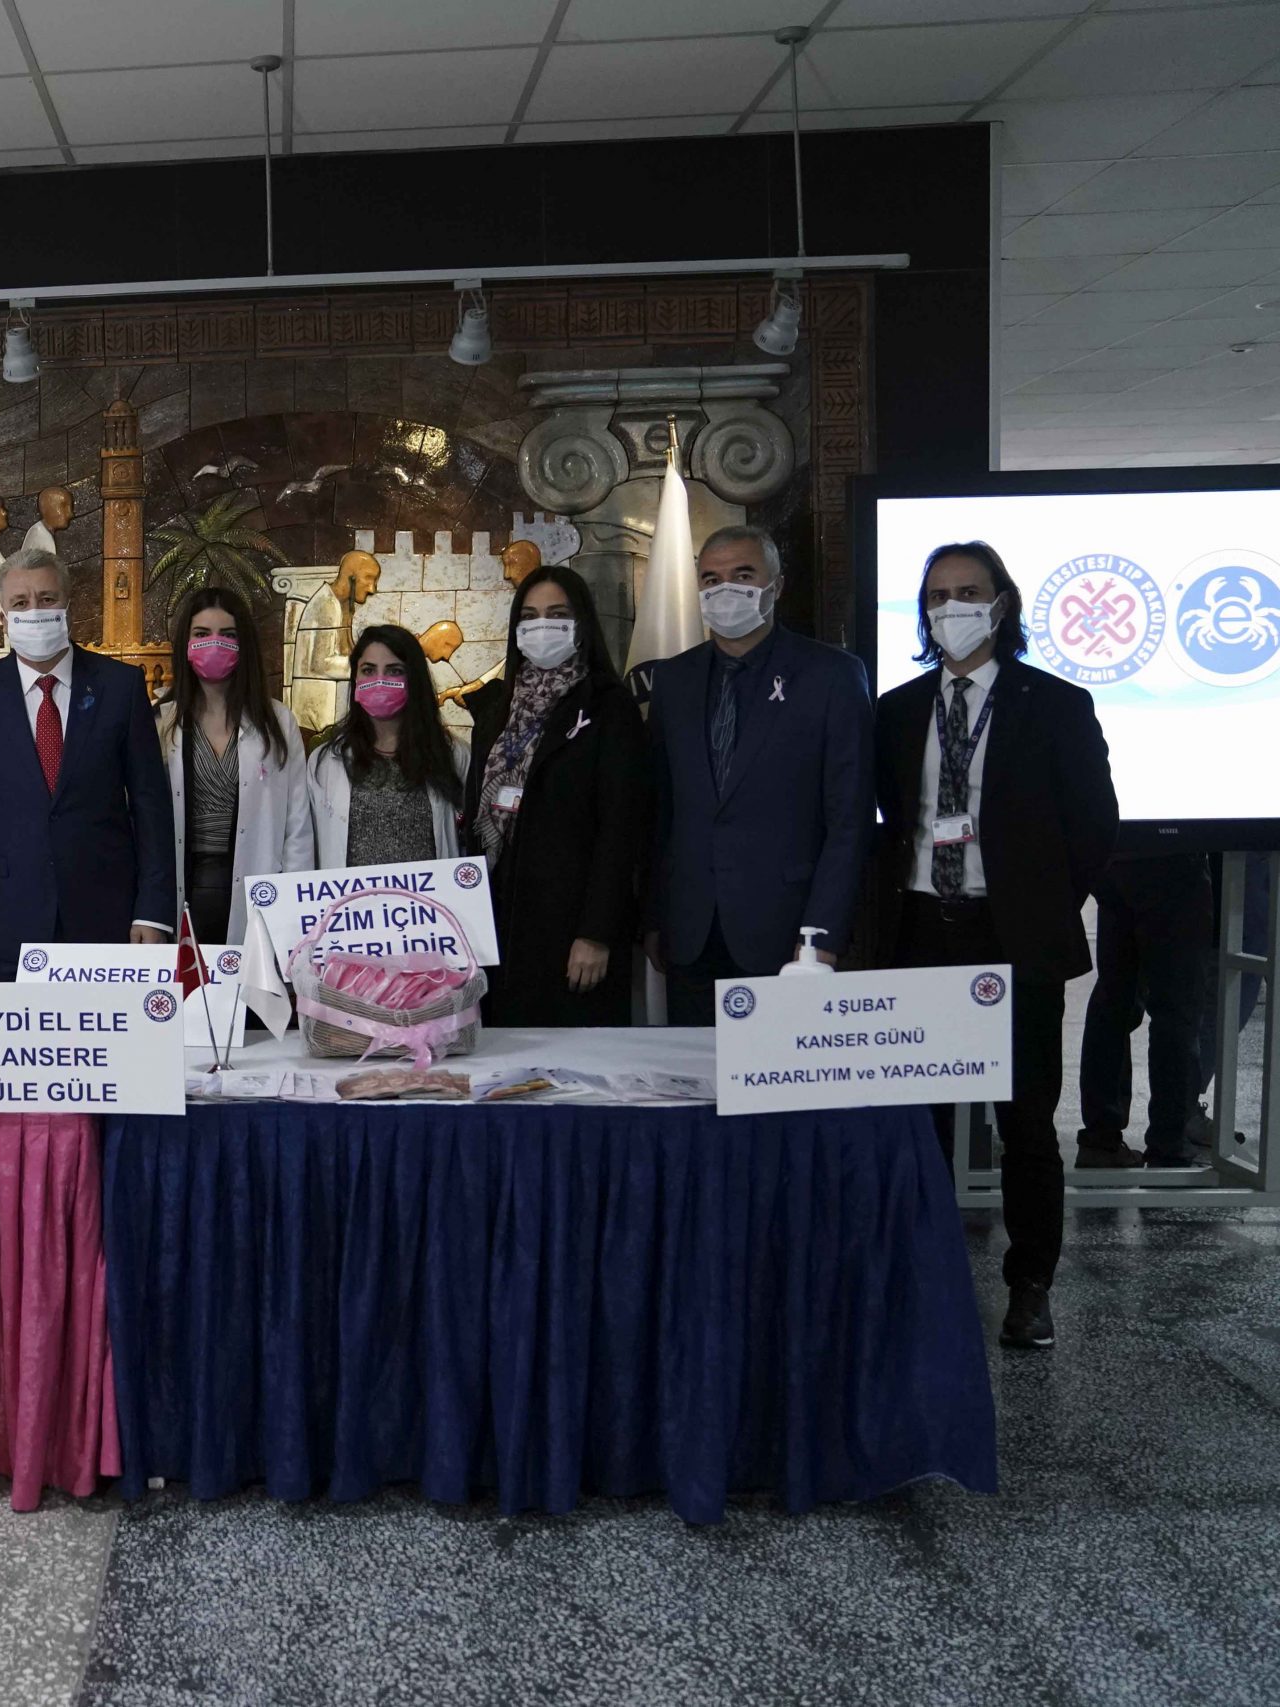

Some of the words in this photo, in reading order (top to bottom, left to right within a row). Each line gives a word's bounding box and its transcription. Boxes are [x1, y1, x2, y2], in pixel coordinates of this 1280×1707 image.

[1118, 559, 1143, 580] TIP
[1033, 555, 1114, 633] ÜNİVERSİTESİ
[1132, 580, 1165, 667] FAKÜLTESİ
[1037, 636, 1063, 667] EGE
[1076, 667, 1118, 682] İZMİR
[296, 872, 436, 903] HAYATINIZ
[382, 901, 437, 932] İÇİN
[288, 932, 458, 966] EERLİDİR
[48, 967, 151, 983] KANSERE
[823, 1000, 833, 1014] 4
[838, 997, 897, 1017] ŞUBAT
[39, 1012, 71, 1032] EL
[79, 1012, 128, 1032] ELE
[796, 1033, 869, 1050] KANSER
[874, 1027, 926, 1046] GÜNÜ
[744, 1067, 851, 1087] KARARLIYIM
[856, 1067, 876, 1080] ve
[880, 1059, 985, 1079] YAPACAĞIM
[46, 1078, 118, 1102] GÜLE
